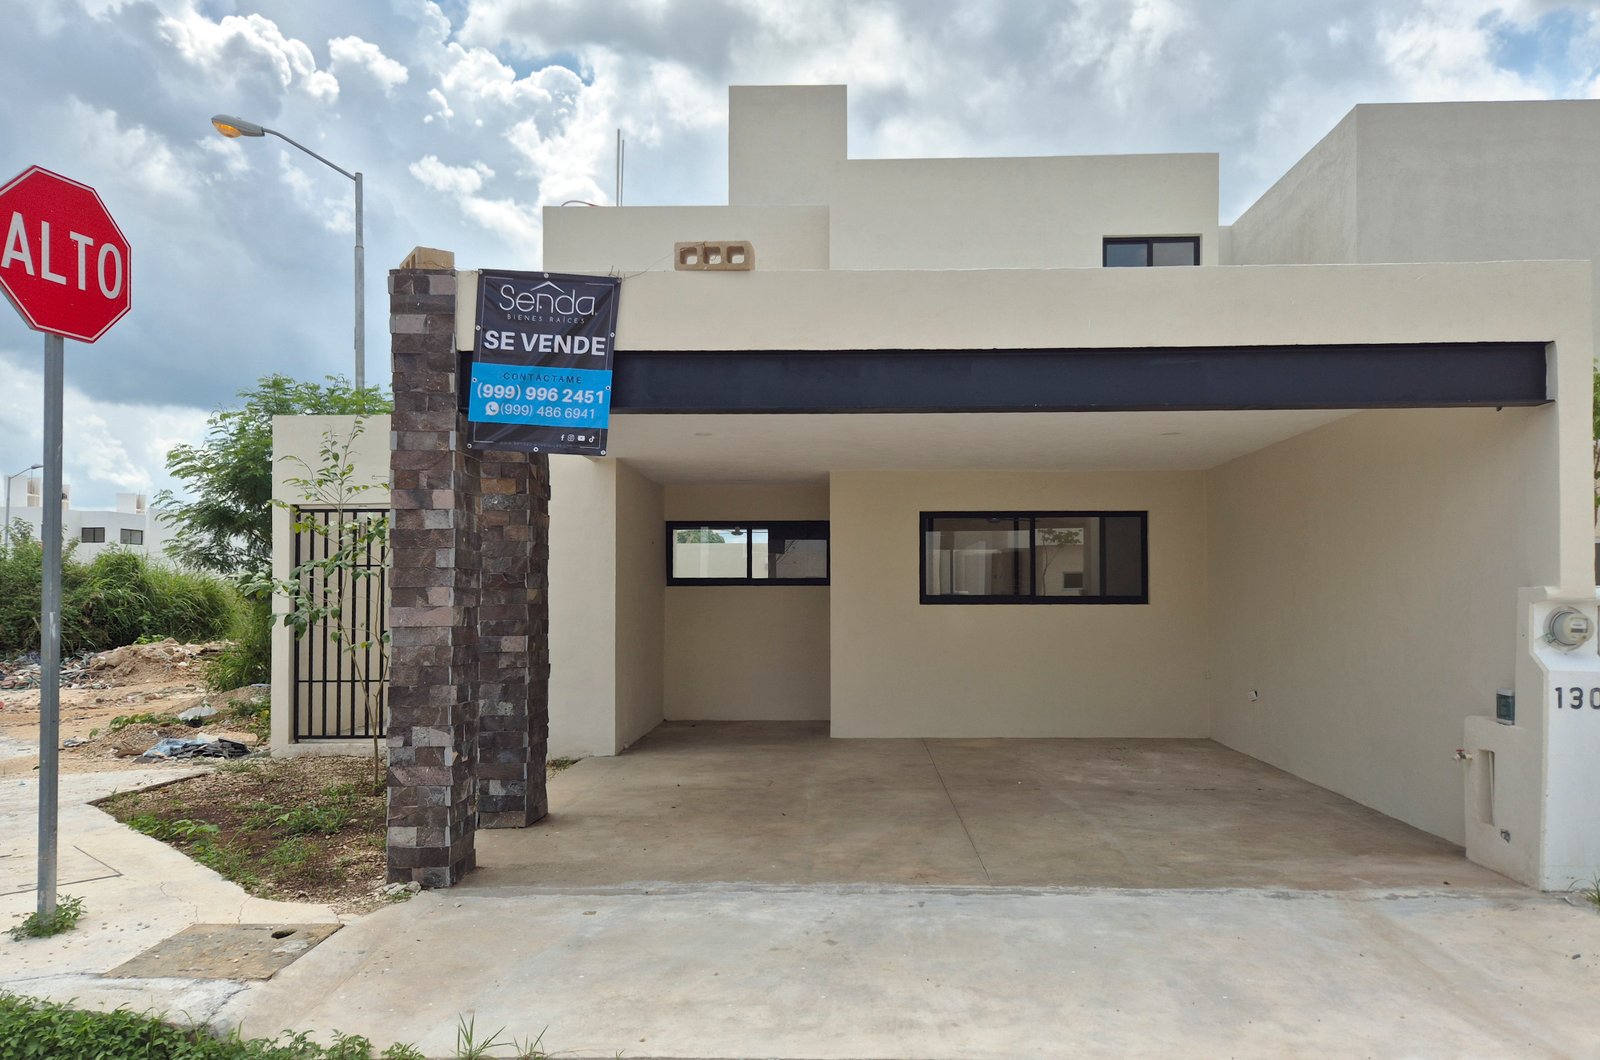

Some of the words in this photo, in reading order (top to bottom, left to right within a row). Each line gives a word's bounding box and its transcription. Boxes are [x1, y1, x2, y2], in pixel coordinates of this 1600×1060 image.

[1, 211, 122, 300] ALTO
[506, 313, 543, 322] BIENES
[549, 314, 585, 324] RAÍCES
[484, 330, 515, 351] SE
[521, 332, 606, 356] VENDE
[503, 371, 582, 384] CONTÁCTAME
[477, 382, 521, 401] (999)
[525, 386, 558, 402] 996
[561, 388, 604, 404] 2451
[500, 403, 533, 417] (999)
[536, 406, 561, 418] 486
[564, 408, 595, 420] 6941
